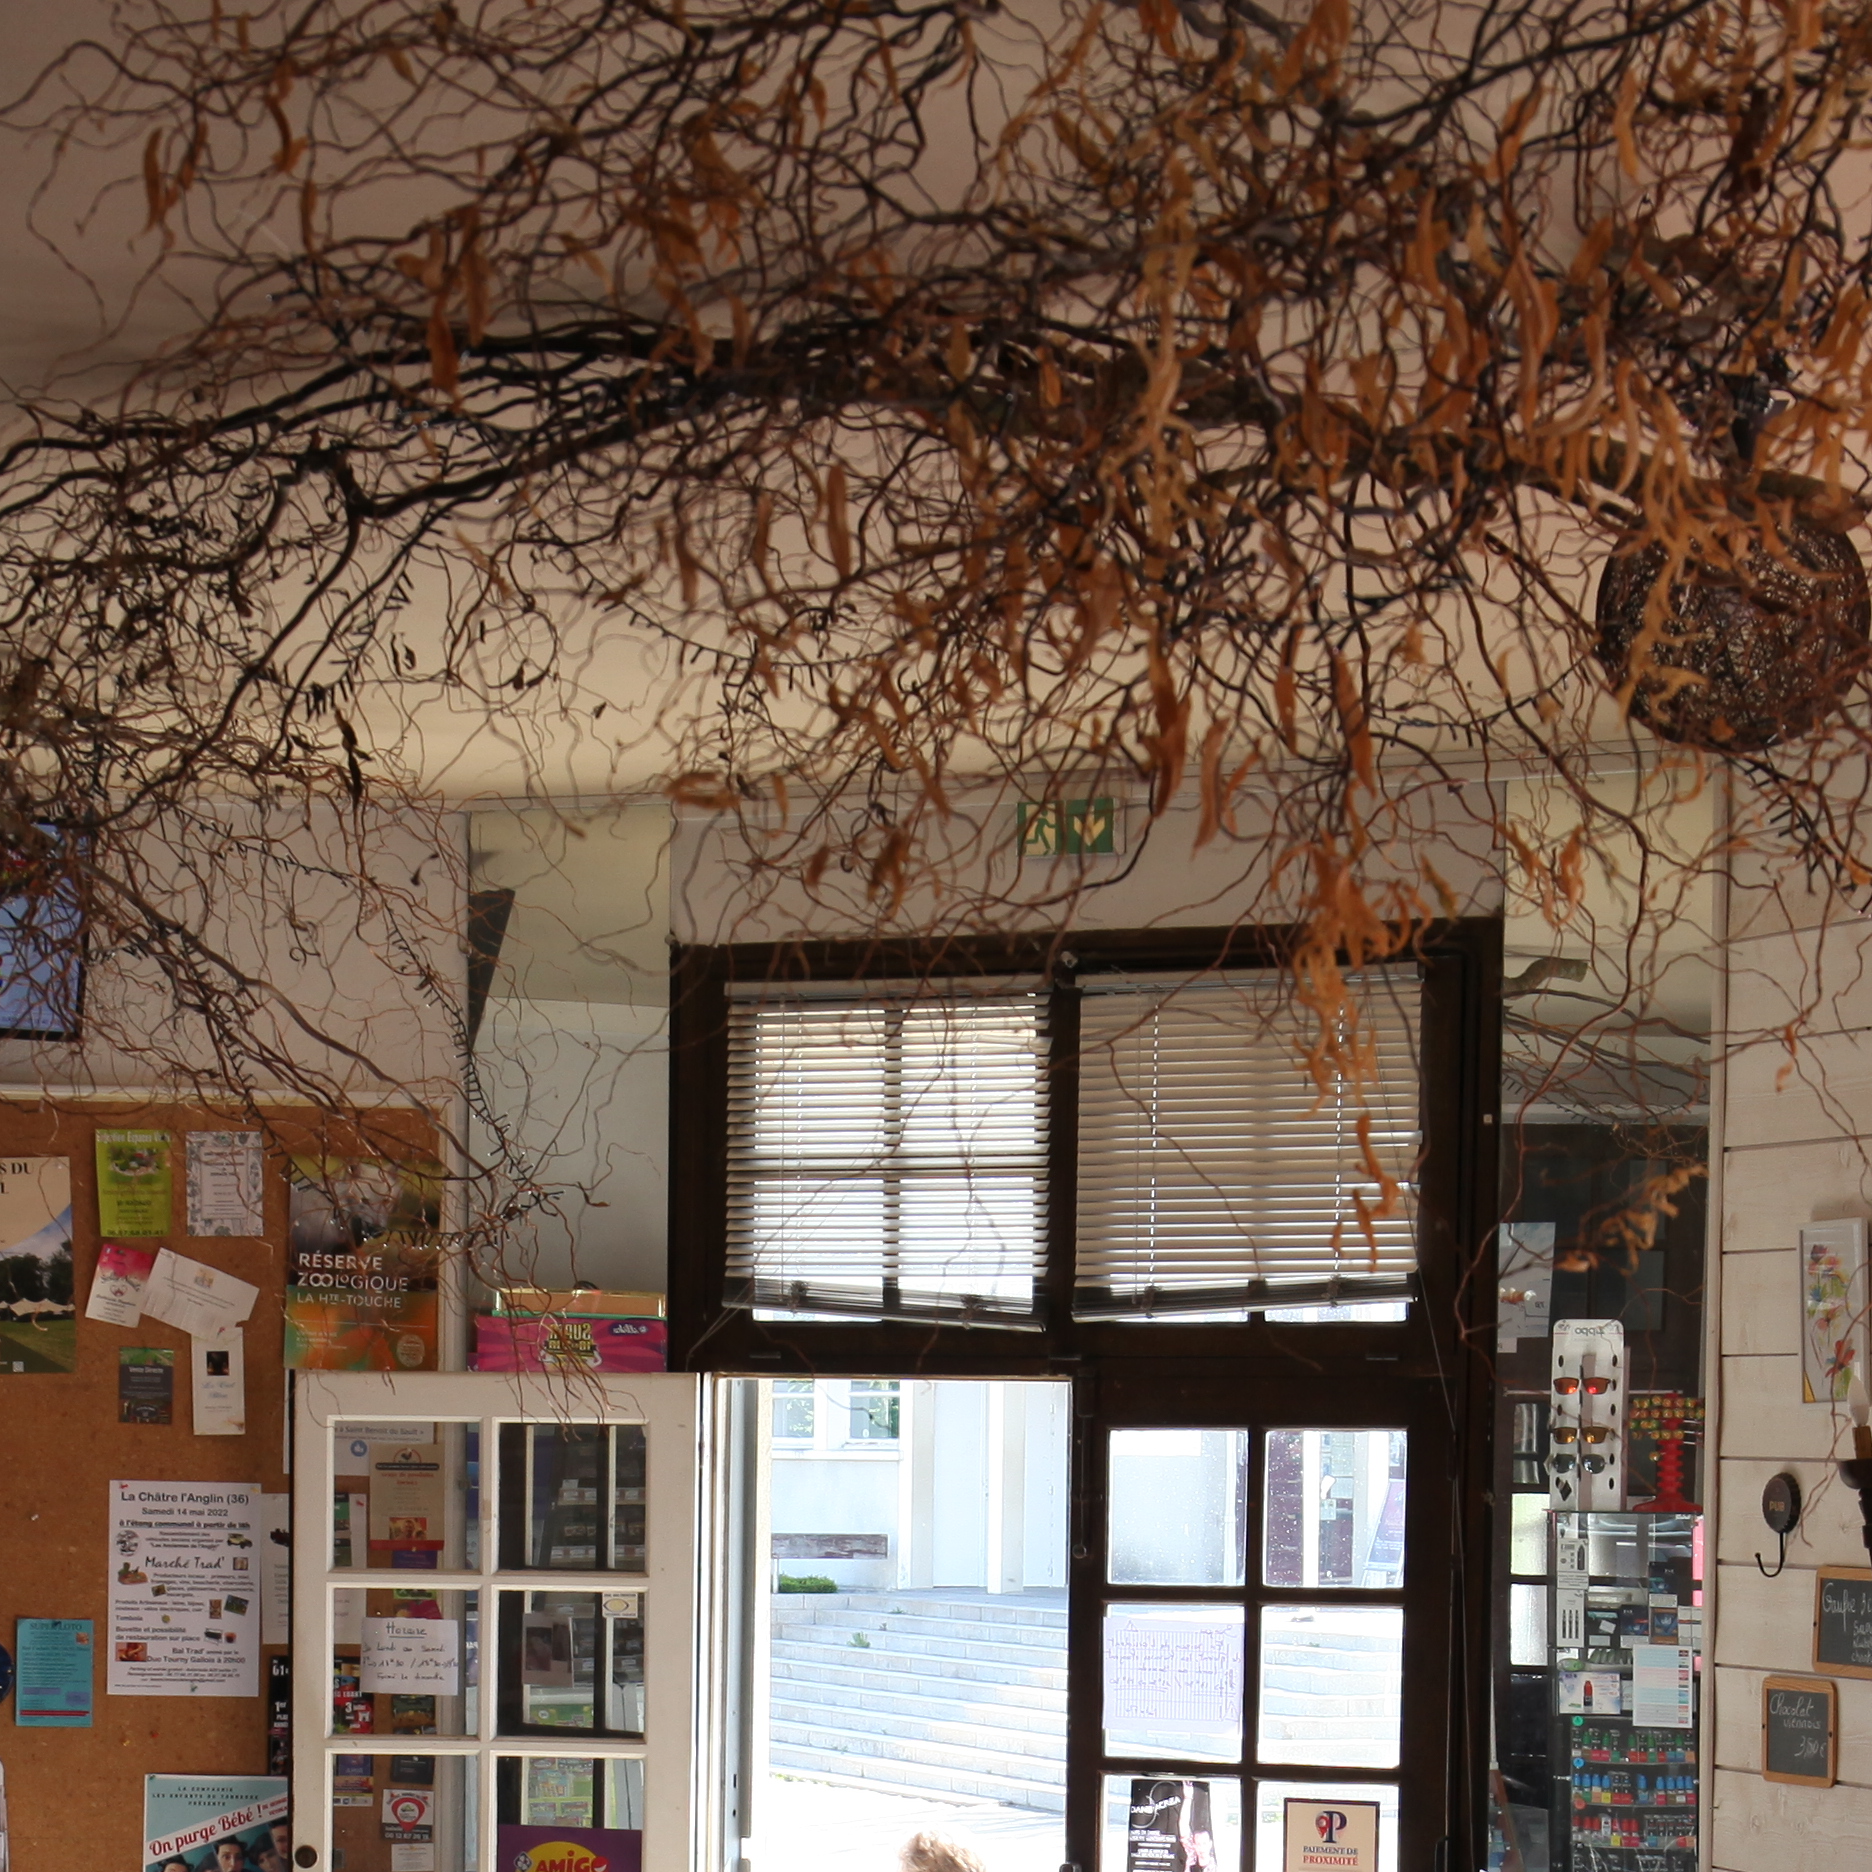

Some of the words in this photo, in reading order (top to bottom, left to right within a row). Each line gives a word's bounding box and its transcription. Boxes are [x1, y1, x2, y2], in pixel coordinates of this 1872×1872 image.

[12, 1161, 34, 1175] DU
[299, 1250, 383, 1271] RÉSERVE
[297, 1293, 314, 1304] LA
[121, 1491, 135, 1502] La
[138, 1491, 178, 1502] Châtre
[181, 1492, 224, 1505] l'Anglin
[226, 1493, 249, 1505] (36)
[142, 1507, 175, 1516] Samedi
[177, 1507, 187, 1516] 14
[189, 1508, 205, 1516] mai
[207, 1508, 229, 1517] 2022
[154, 1520, 195, 1528] communal
[203, 1521, 226, 1529] partir
[145, 1556, 189, 1569] Marché
[149, 1839, 173, 1856] On
[175, 1824, 218, 1852] purge
[218, 1805, 254, 1832] Bébé
[1303, 1845, 1346, 1855] PAIEMENT
[1346, 1847, 1359, 1856] DE
[1303, 1854, 1359, 1866] PROXIMITÉ
